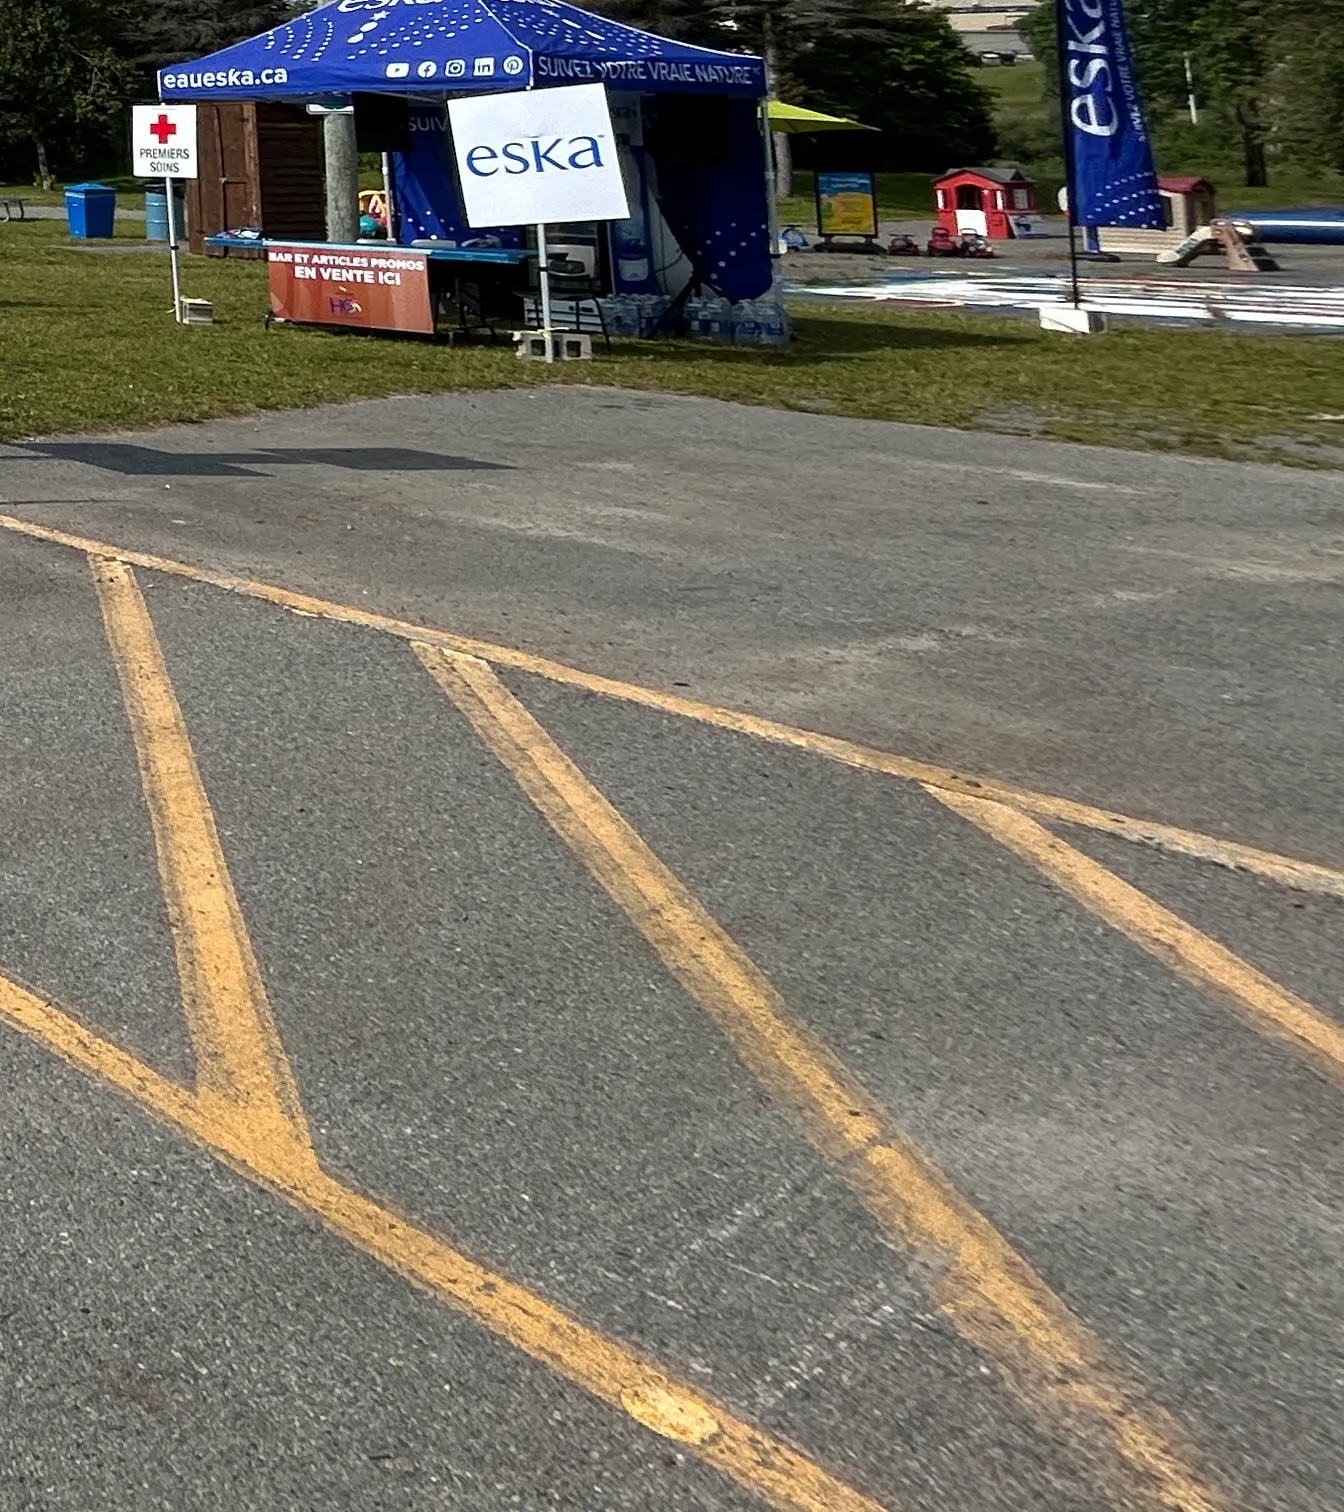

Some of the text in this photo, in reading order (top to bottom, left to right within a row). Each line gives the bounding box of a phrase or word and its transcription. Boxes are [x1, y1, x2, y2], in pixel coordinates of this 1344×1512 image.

[163, 67, 288, 89] eaueska.ca
[538, 55, 595, 79] SUIVEZ
[593, 60, 647, 80] VOTRE
[647, 61, 696, 82] VRAIE
[695, 65, 754, 85] NATURE
[139, 148, 190, 160] PREMIERS
[466, 135, 605, 177] eska
[149, 161, 180, 173] SOINS
[268, 251, 425, 272] BAR ET ARTICLES PROMOS
[294, 265, 401, 286] EN VENTE ICI
